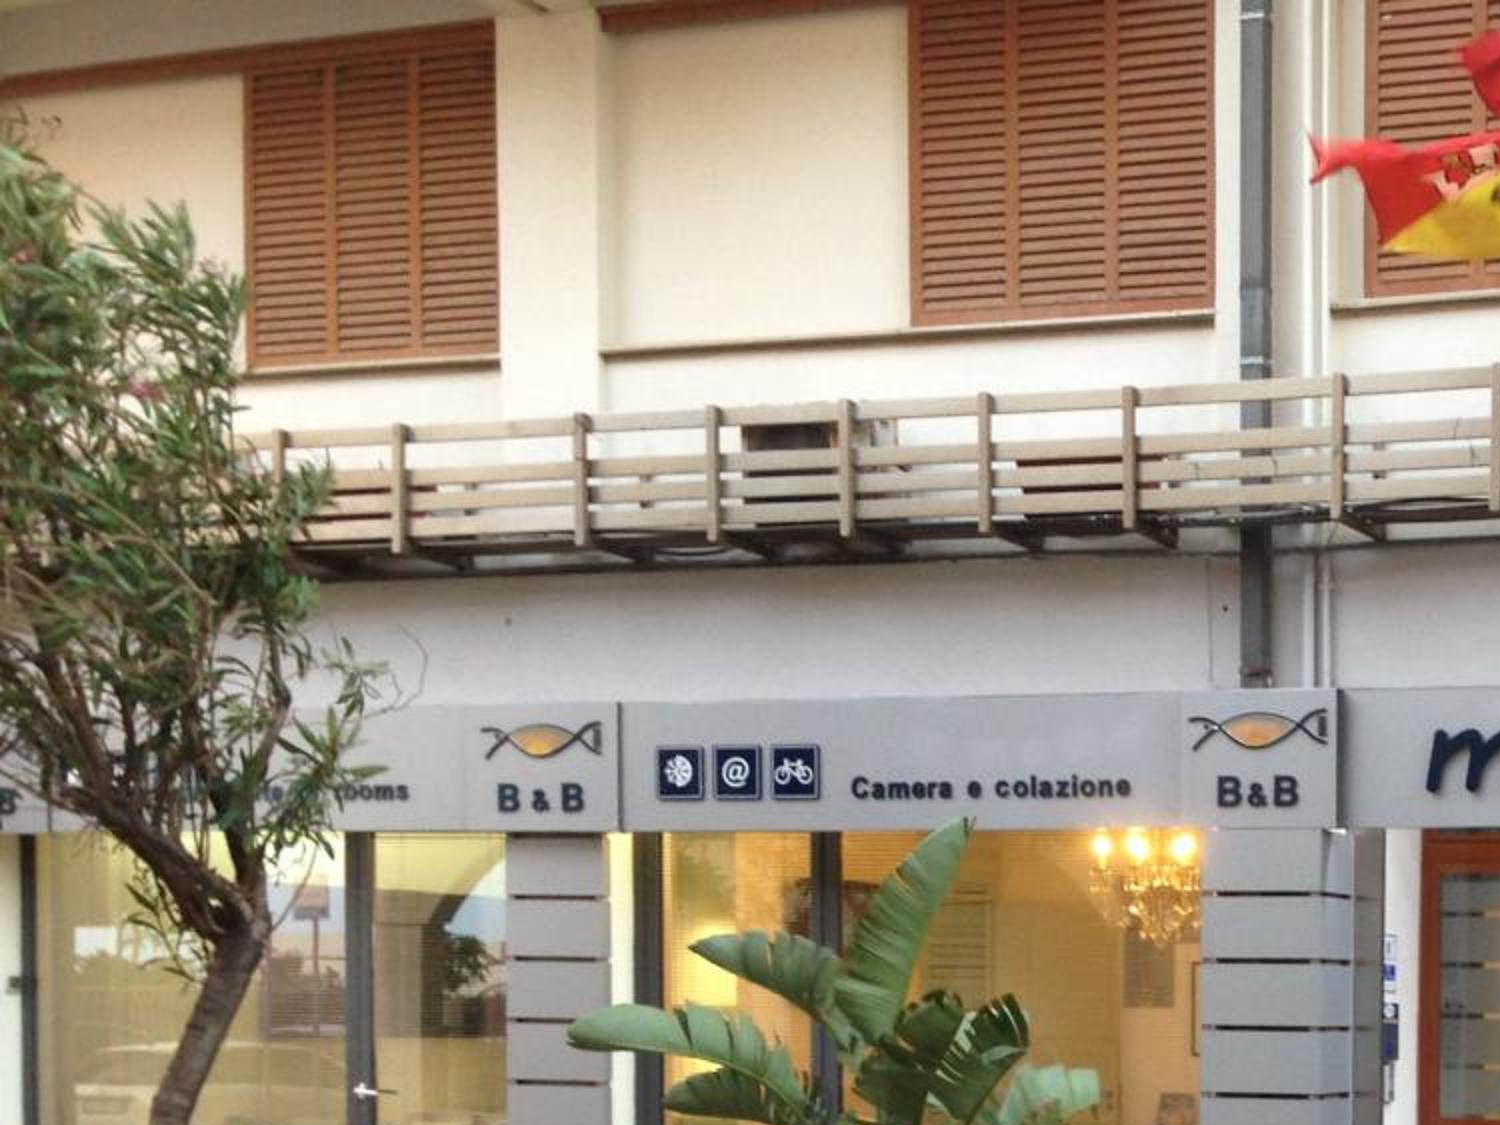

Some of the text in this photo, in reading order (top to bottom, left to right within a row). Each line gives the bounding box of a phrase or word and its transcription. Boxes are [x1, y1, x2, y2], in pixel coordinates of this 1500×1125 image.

[334, 784, 410, 801] ooms
[850, 774, 1132, 800] Camera e colazione
